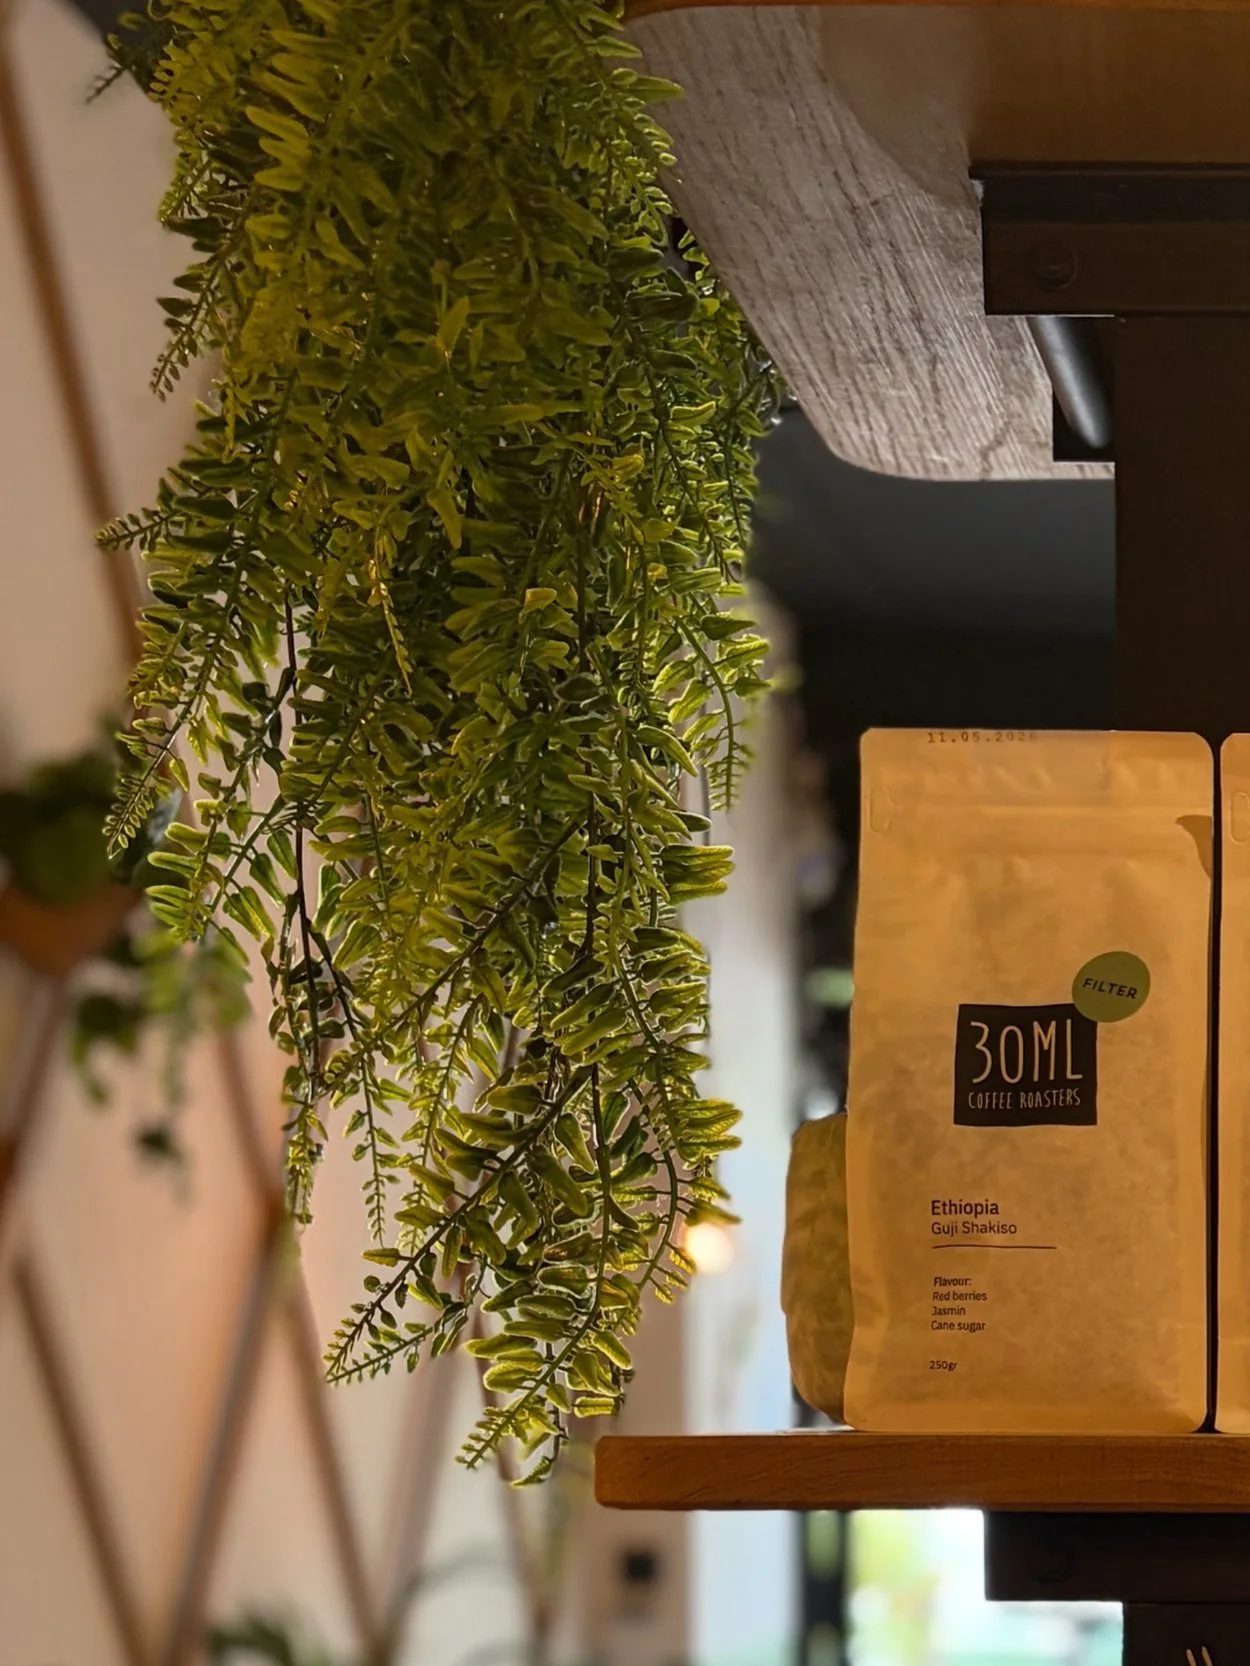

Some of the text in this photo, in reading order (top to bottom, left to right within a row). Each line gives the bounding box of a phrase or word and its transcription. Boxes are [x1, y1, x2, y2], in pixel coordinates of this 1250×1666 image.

[1082, 977, 1138, 1000] FILTER
[970, 1018, 1083, 1084] 30ML
[968, 1088, 1081, 1110] COFFEE ROASTERS
[931, 1199, 1000, 1218] Ethiopia
[931, 1221, 1017, 1237] Guji Shakiso
[933, 1276, 972, 1287] Flavour:
[932, 1291, 988, 1301] Red berries
[931, 1306, 966, 1316] Jasmin
[931, 1320, 986, 1333] Cane sugar
[929, 1360, 958, 1372] 250gr
